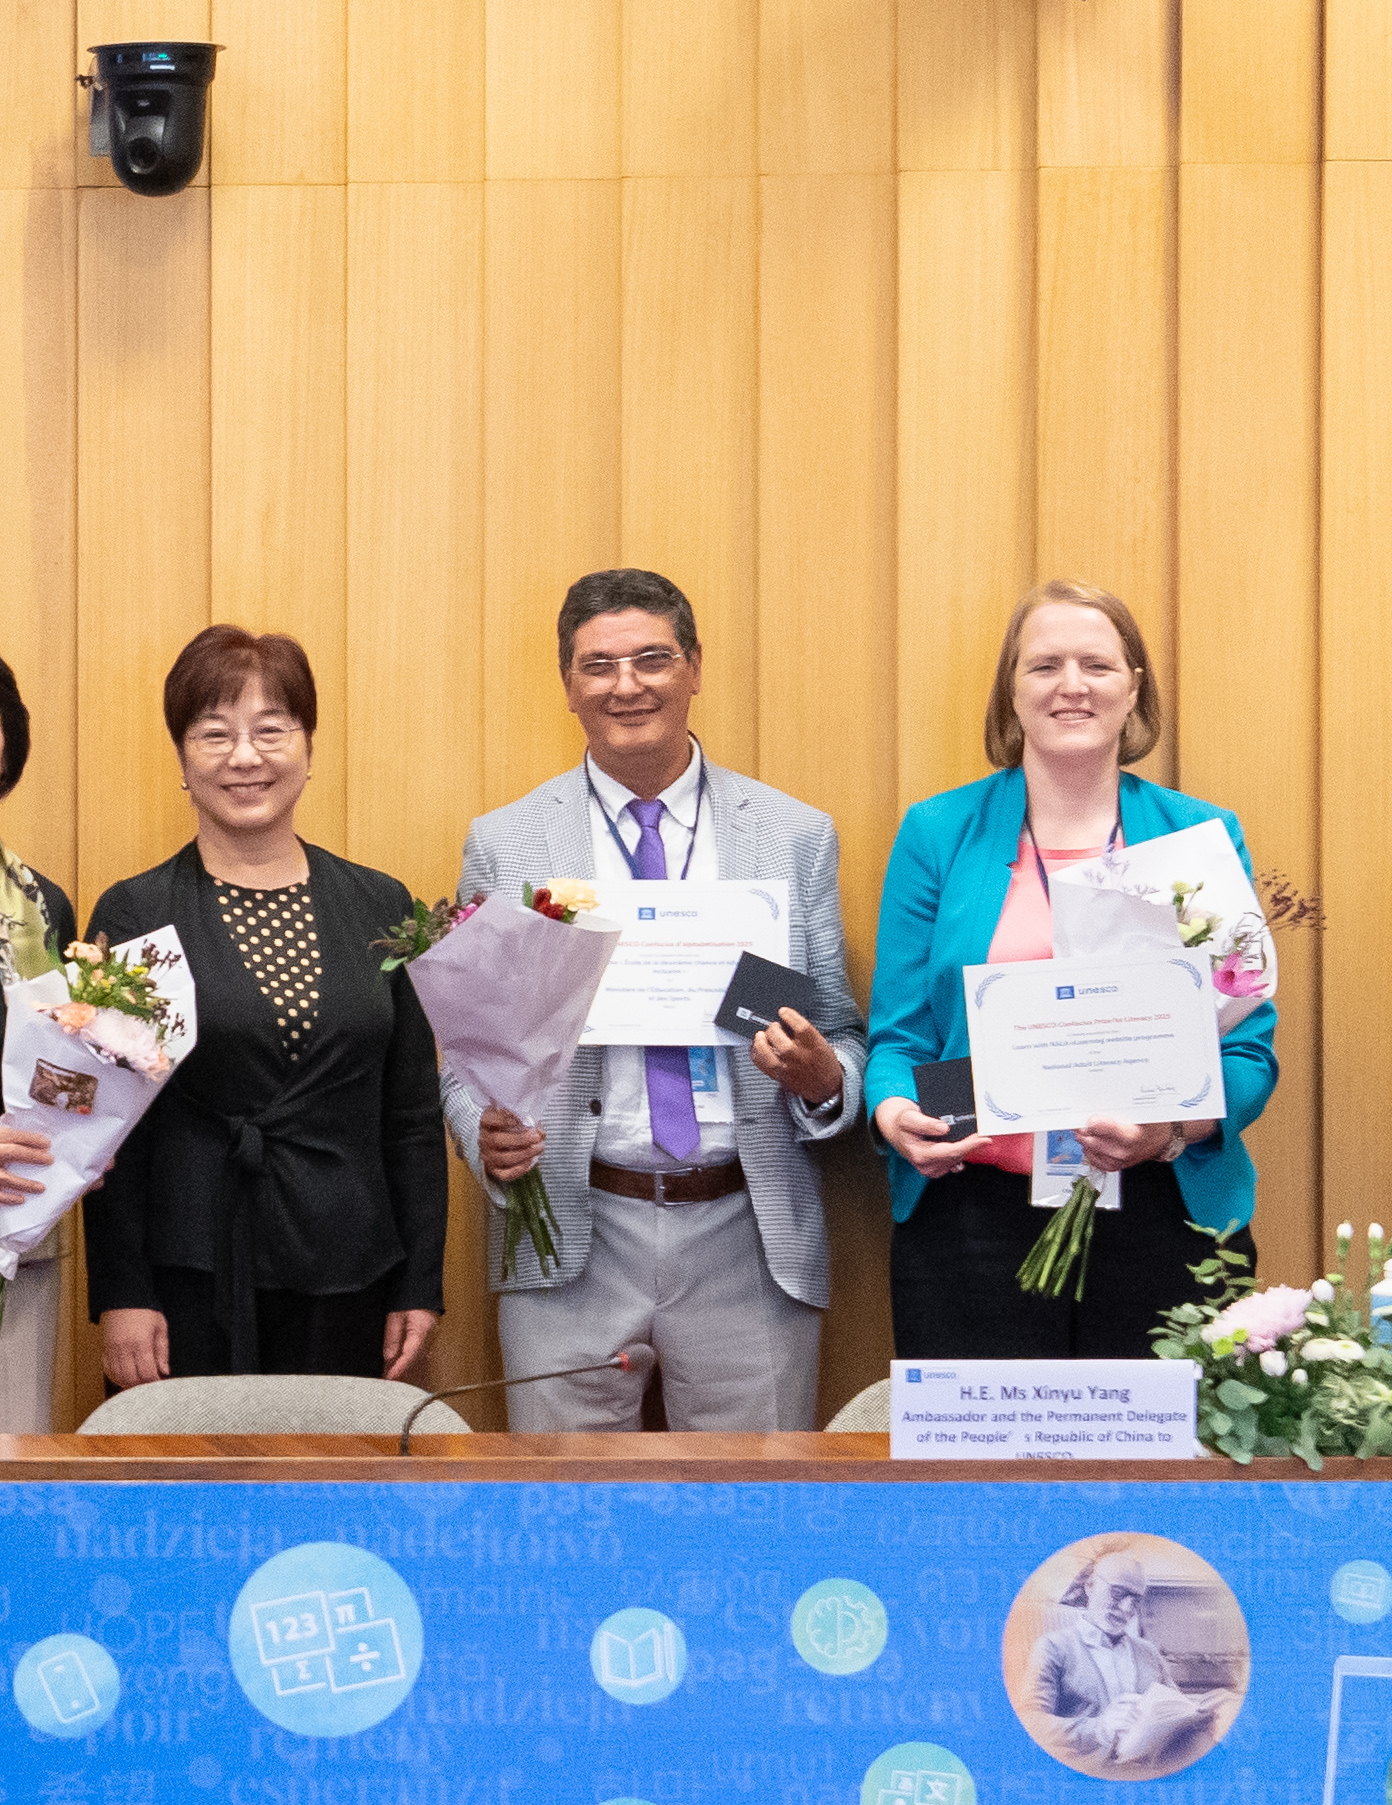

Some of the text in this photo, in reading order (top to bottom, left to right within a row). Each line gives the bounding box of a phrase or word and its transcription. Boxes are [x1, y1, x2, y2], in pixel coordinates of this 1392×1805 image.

[1078, 985, 1118, 995] unesco
[960, 1385, 1131, 1404] H.E. Ms Xinyu Yang
[901, 1410, 1188, 1424] Ambassador and the Permanent Delegate
[916, 1430, 933, 1443] of
[934, 1431, 957, 1443] the
[1034, 1431, 1094, 1446] Republic
[1097, 1430, 1112, 1443] of
[1116, 1431, 1154, 1443] China
[1157, 1431, 1172, 1443] to
[266, 1611, 319, 1645] 123
